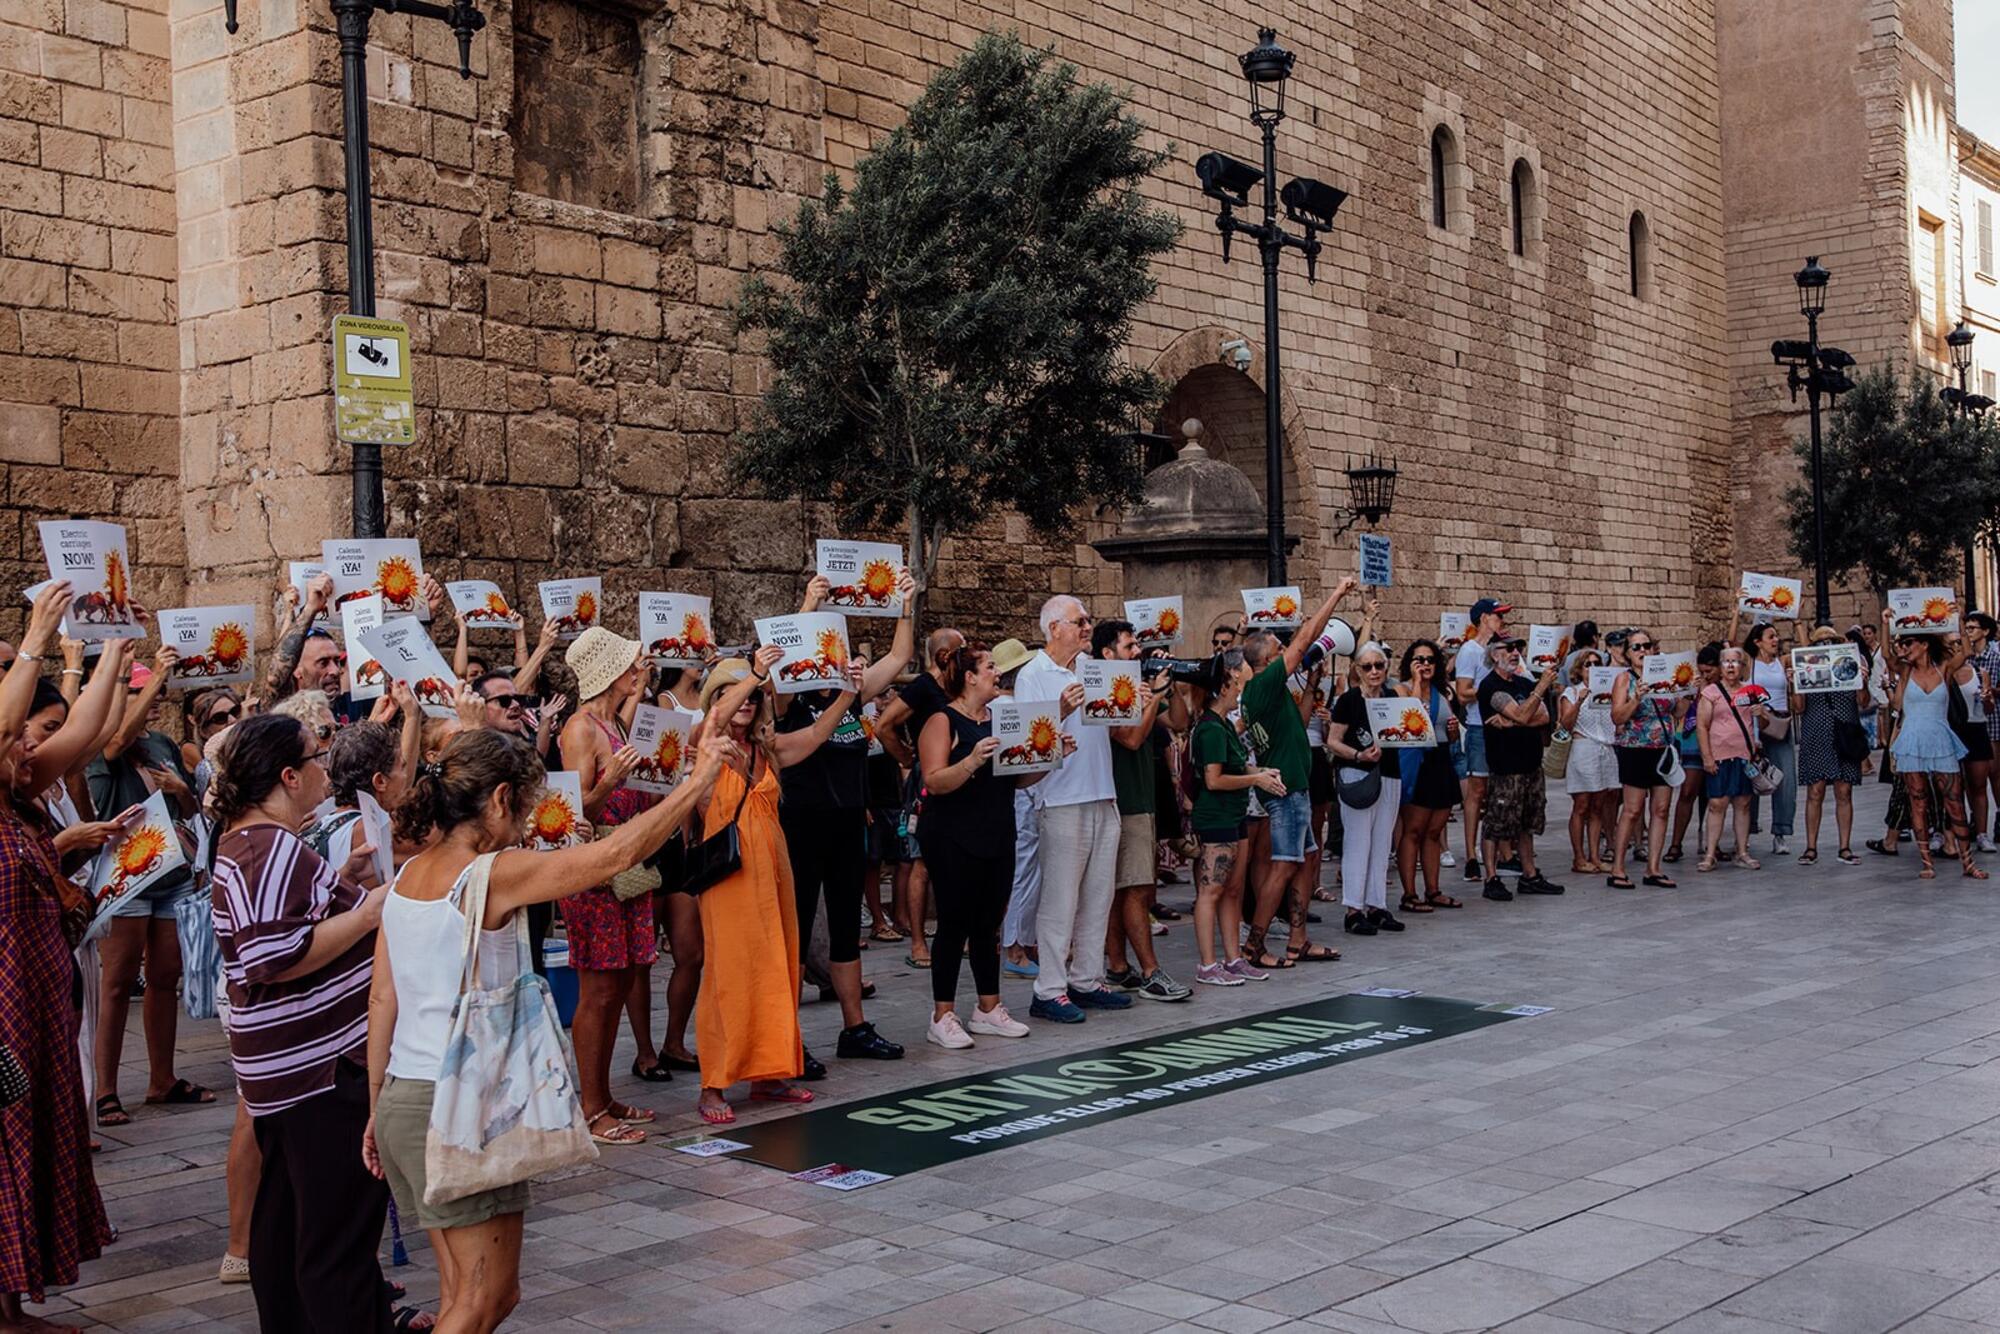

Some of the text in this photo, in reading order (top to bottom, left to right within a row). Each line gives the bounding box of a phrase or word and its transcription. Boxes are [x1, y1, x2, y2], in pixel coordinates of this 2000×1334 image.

[340, 320, 356, 328] ZONA
[60, 529, 88, 538] Electric
[62, 552, 95, 566] NOW!
[342, 562, 361, 574] ¡YA!
[826, 560, 856, 570] JETZT!
[655, 613, 667, 622] YA
[770, 621, 794, 629] Electric
[179, 629, 197, 641] ¡YA!
[382, 628, 409, 641] Calesas
[772, 634, 803, 646] NOW!
[1084, 677, 1103, 685] NOW!
[1000, 721, 1020, 731] NOW!
[636, 727, 654, 738] NOW!
[847, 1016, 1383, 1132] SATYA ANIMAL
[950, 1113, 1069, 1144] PORQUE
[1052, 1097, 1139, 1118] ELLOS
[1126, 1088, 1175, 1100] NO
[1161, 1067, 1261, 1091] PUEDEN
[1319, 1038, 1384, 1053] PERO
[1368, 1031, 1410, 1040] TÚ
